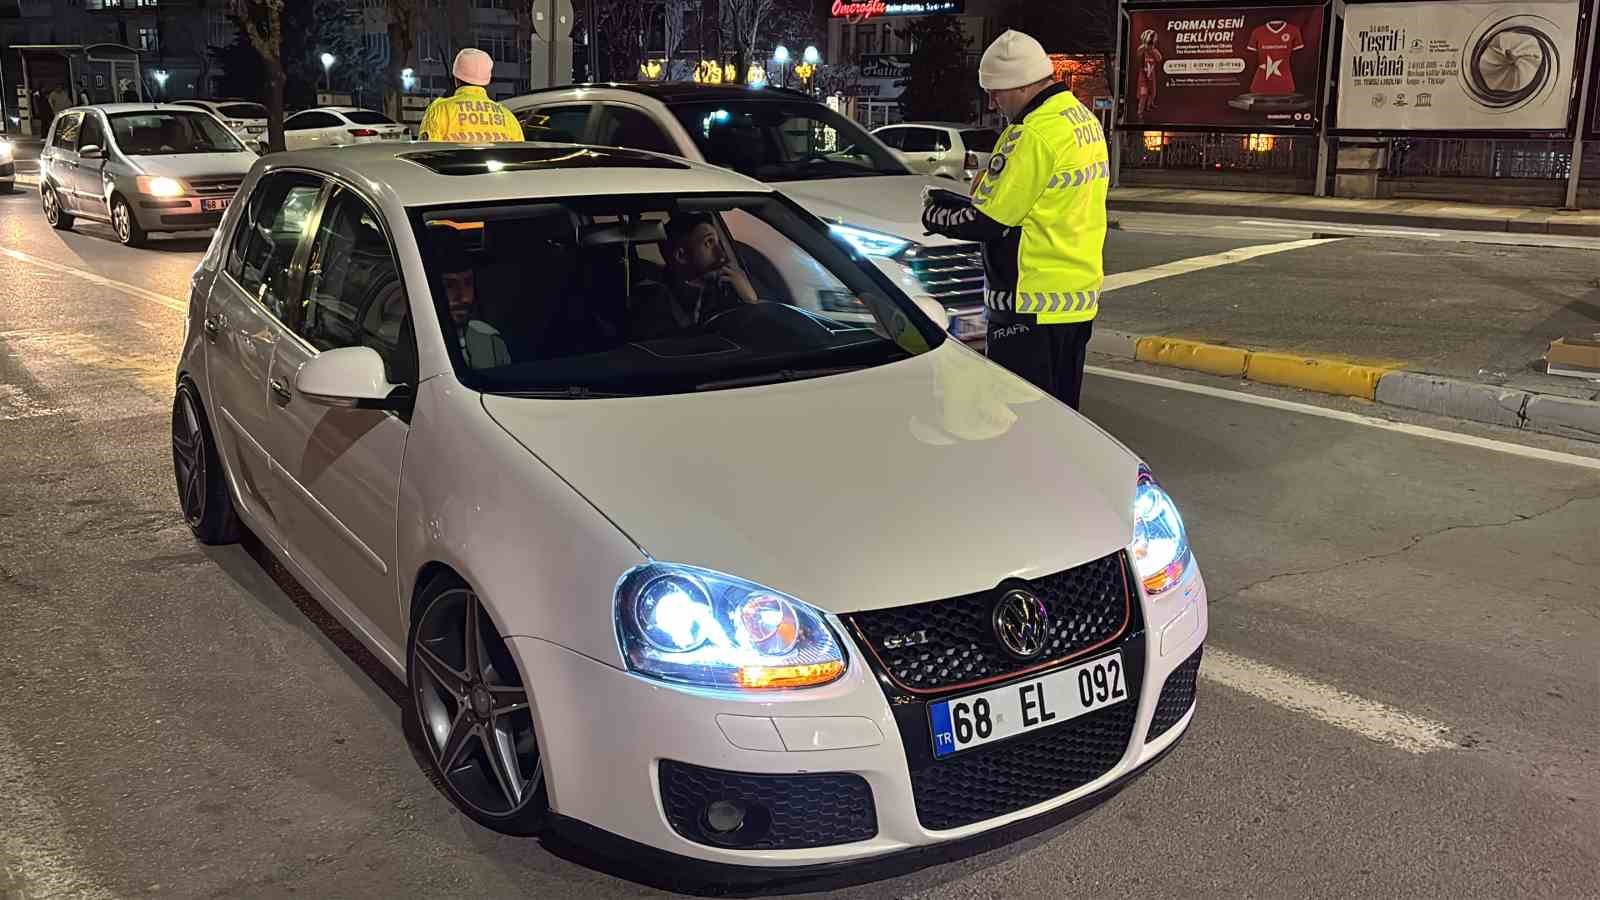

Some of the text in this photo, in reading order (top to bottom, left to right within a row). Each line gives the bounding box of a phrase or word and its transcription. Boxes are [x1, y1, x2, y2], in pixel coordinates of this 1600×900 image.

[1168, 15, 1245, 30] FORMAN SENİ
[1176, 29, 1234, 43] BEKLİYOR!
[936, 658, 1125, 746] TR 68 EL 092
